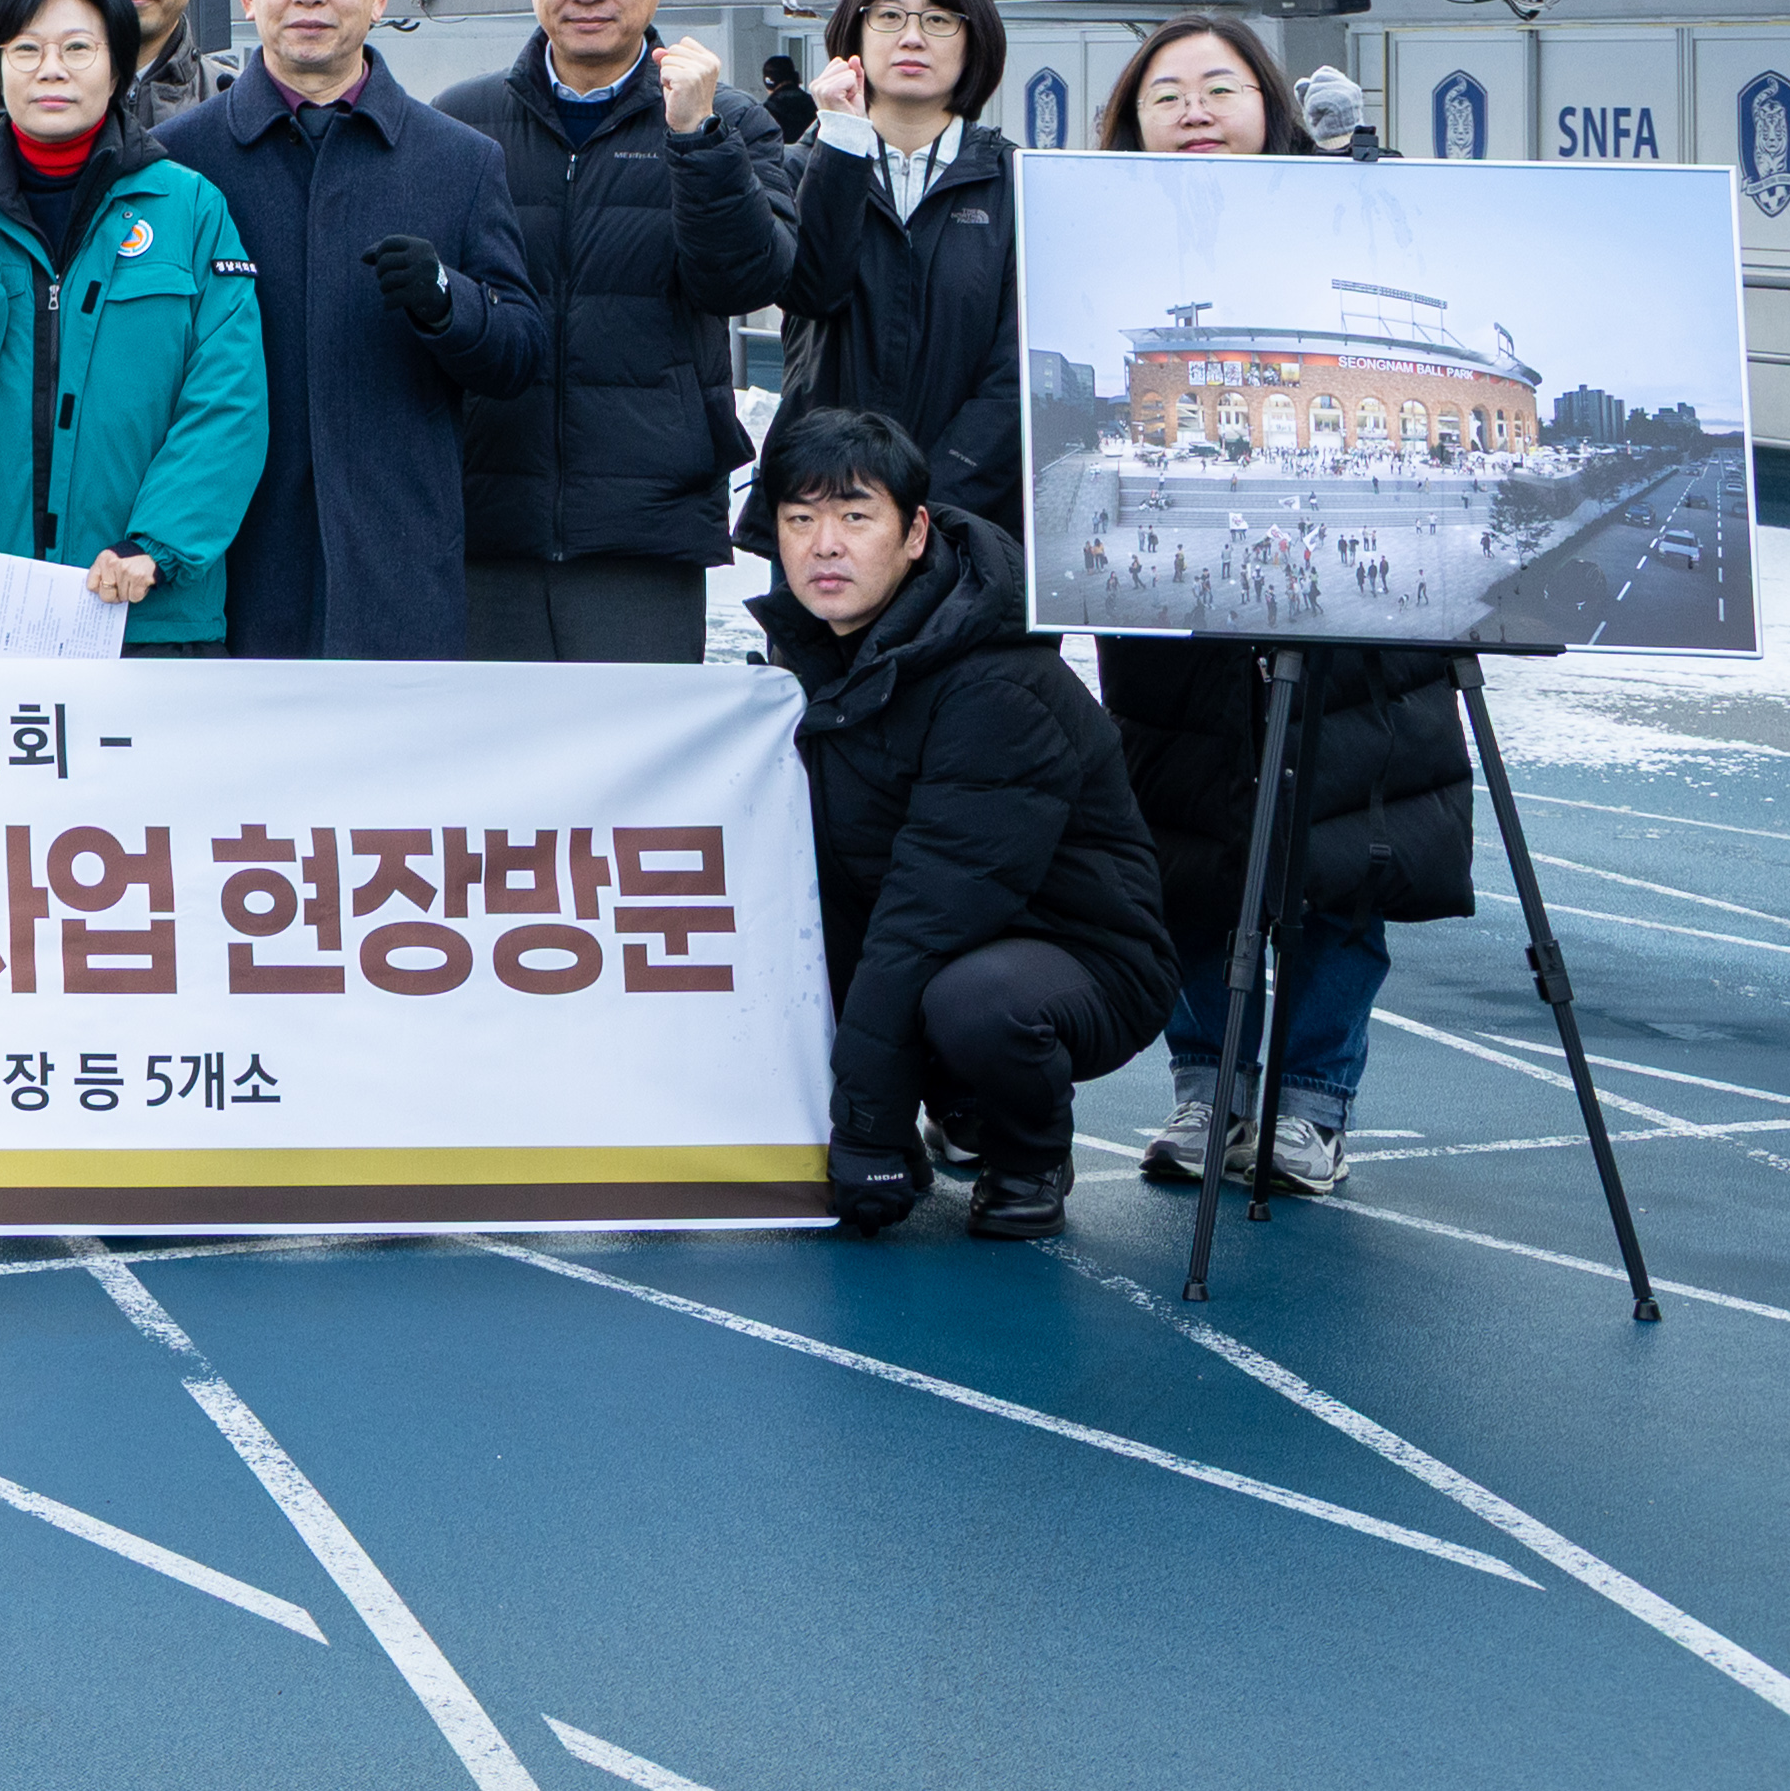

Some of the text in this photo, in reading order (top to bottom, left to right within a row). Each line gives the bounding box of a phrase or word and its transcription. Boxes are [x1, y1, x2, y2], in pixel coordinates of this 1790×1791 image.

[1558, 106, 1659, 159] SNFA
[1338, 356, 1474, 380] SEONGNAM BALL PARK
[211, 824, 736, 996] 현장방문
[73, 1052, 125, 1112] 등
[146, 1051, 281, 1112] 5개소
